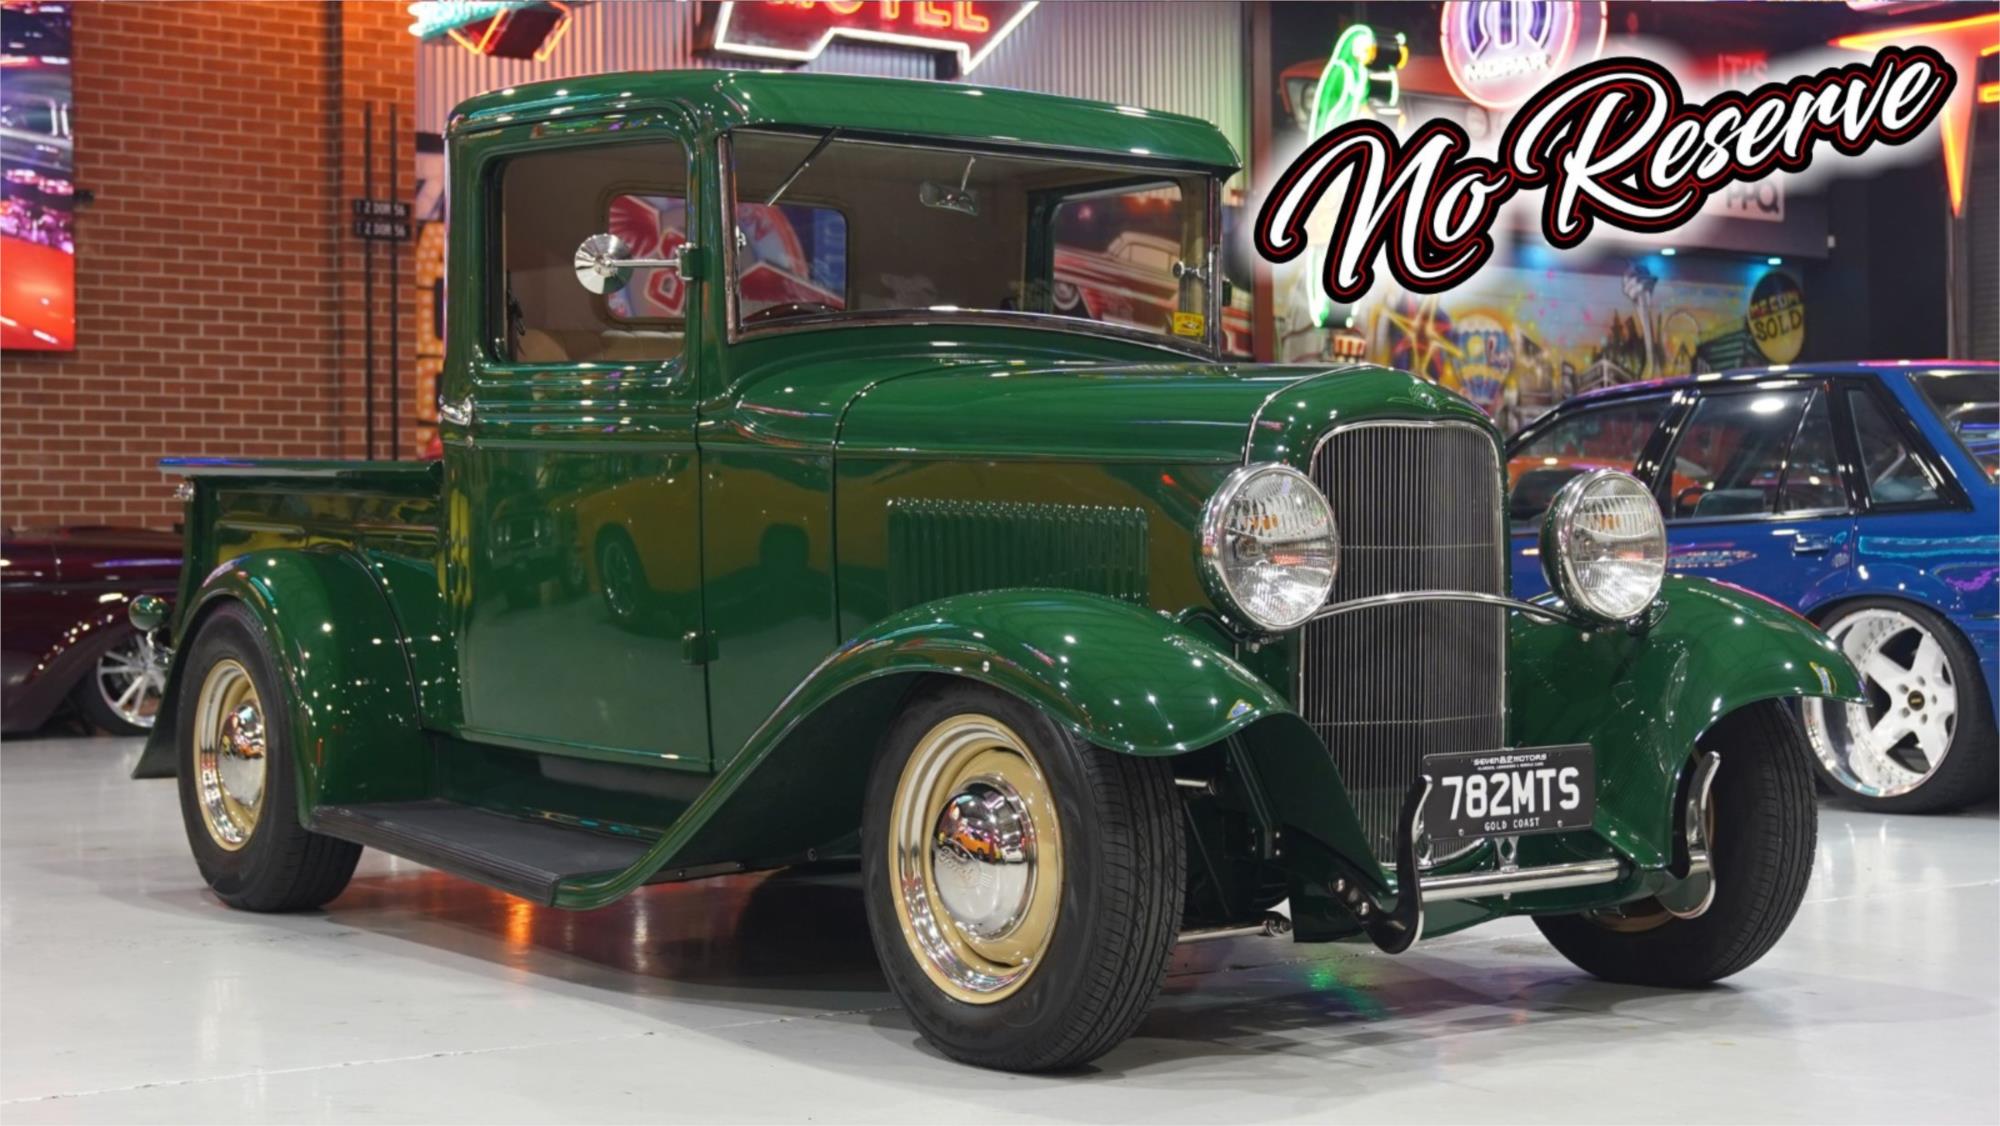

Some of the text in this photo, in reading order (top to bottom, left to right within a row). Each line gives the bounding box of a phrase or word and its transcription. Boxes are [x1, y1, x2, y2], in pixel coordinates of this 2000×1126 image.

[1464, 50, 1552, 82] MOPAR
[1753, 309, 1803, 342] SOLD
[1441, 766, 1580, 821] 782MTS
[1484, 817, 1541, 832] GOLD COAST
